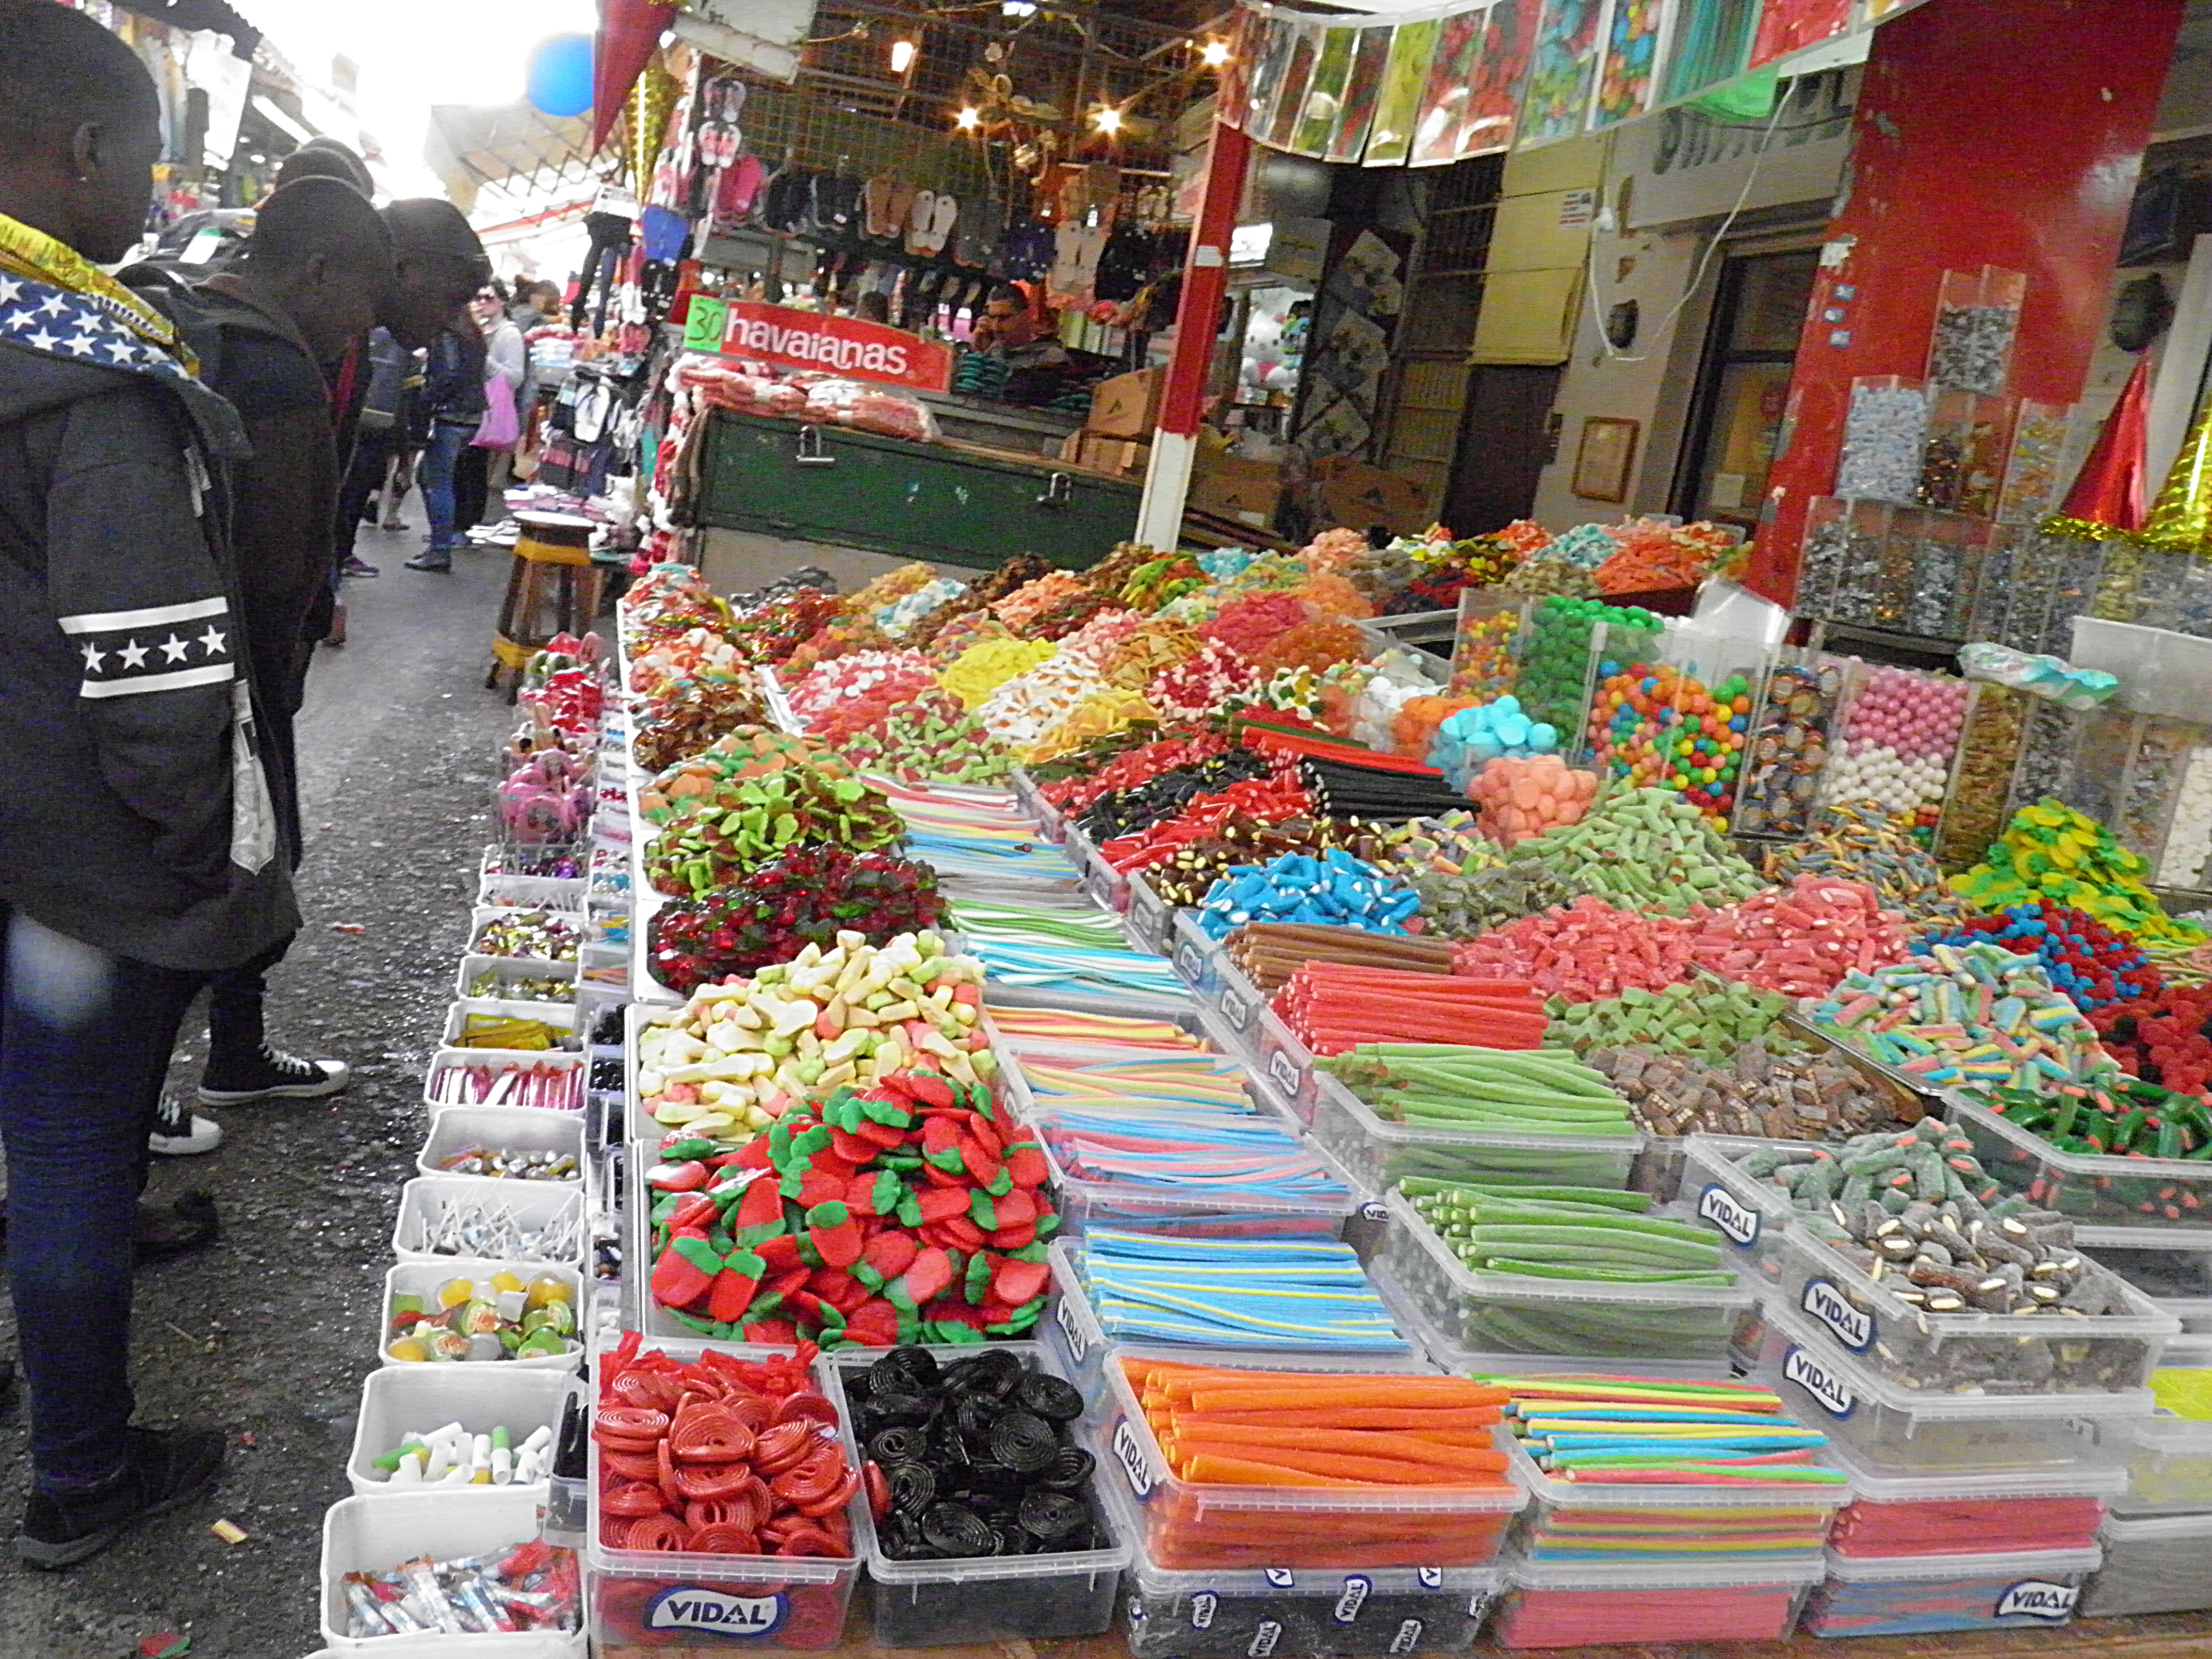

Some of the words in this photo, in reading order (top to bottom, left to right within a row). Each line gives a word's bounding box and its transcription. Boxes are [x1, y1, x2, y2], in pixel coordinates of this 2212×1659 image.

[725, 308, 906, 375] havaianas
[1275, 1056, 1296, 1090] VIDAL
[1367, 1210, 1390, 1219] VID
[1710, 1194, 1750, 1238] VIDAL
[1063, 1300, 1082, 1357] VIDAL
[1815, 1288, 1863, 1342] VIDAL
[1796, 1355, 1845, 1408] VIDAL
[1120, 1427, 1147, 1490] VIDAL
[668, 1600, 767, 1625] VIDAL
[1341, 1583, 1364, 1617] VIDAL
[2013, 1591, 2070, 1608] VIDAL
[1254, 1624, 1277, 1656] VIDAL
